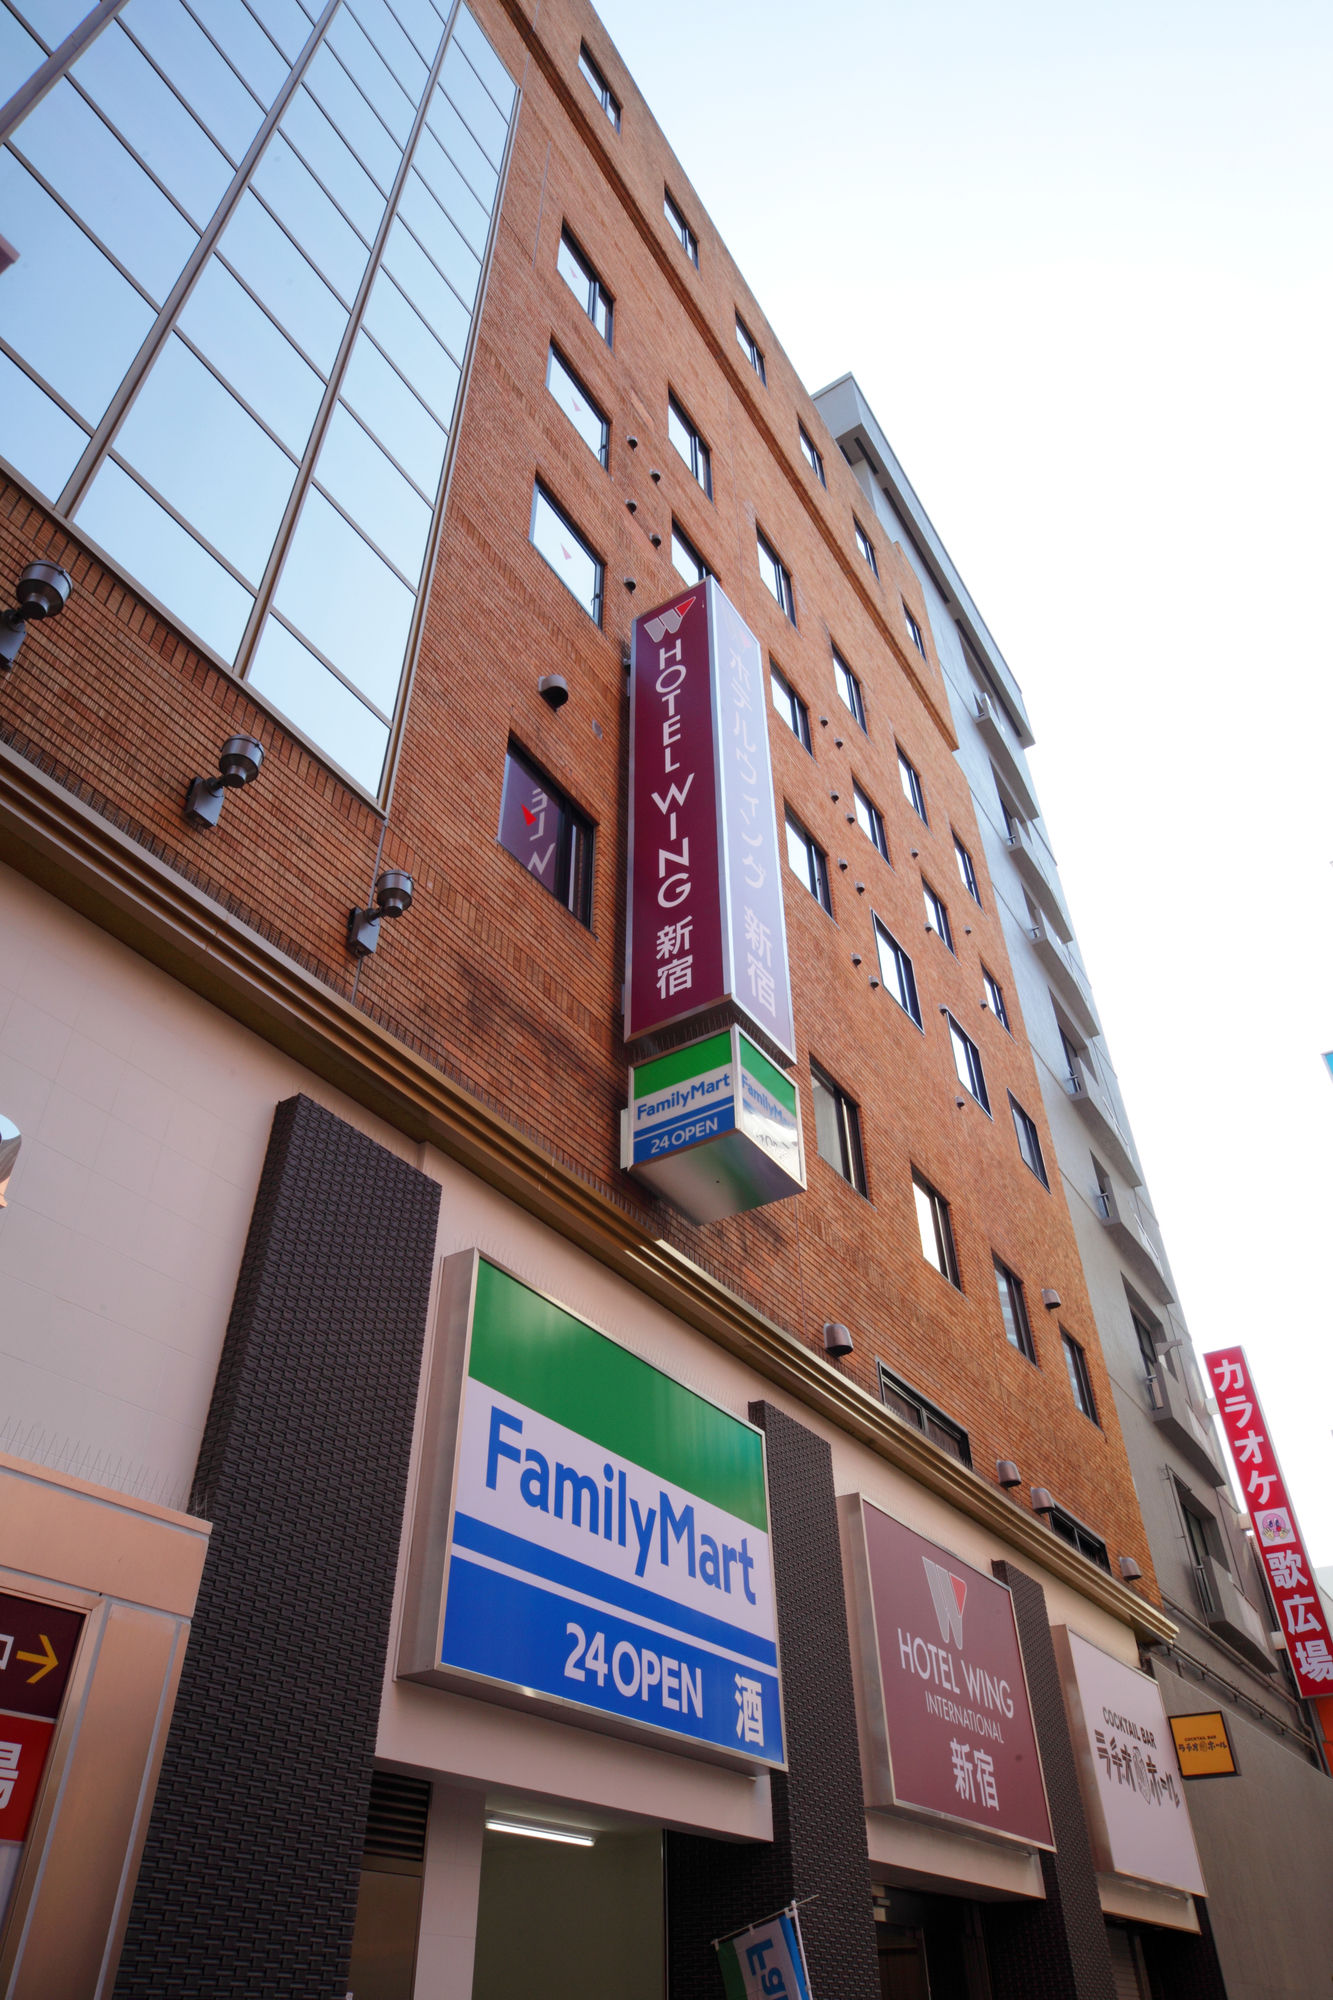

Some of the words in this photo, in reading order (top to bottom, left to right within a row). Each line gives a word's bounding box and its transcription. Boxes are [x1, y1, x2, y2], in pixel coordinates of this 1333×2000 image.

[655, 638, 687, 774] HOTEL
[651, 772, 695, 909] WING
[656, 914, 694, 1000] 新宿
[743, 903, 778, 1018] 新宿
[637, 1073, 730, 1121] FamilyMart
[486, 1405, 757, 1605] FamilyMart
[1214, 1358, 1278, 1505] カラオケ
[1266, 1549, 1333, 1682] 歌広場
[734, 1671, 765, 1748] 酒
[897, 1628, 960, 1694] HOTEL
[960, 1659, 1014, 1719] WING
[925, 1690, 1005, 1744] INTERNATIONAL
[1102, 1706, 1141, 1742] COCKTAIL
[1140, 1726, 1157, 1749] BAR
[950, 1738, 1000, 1812] 新宿
